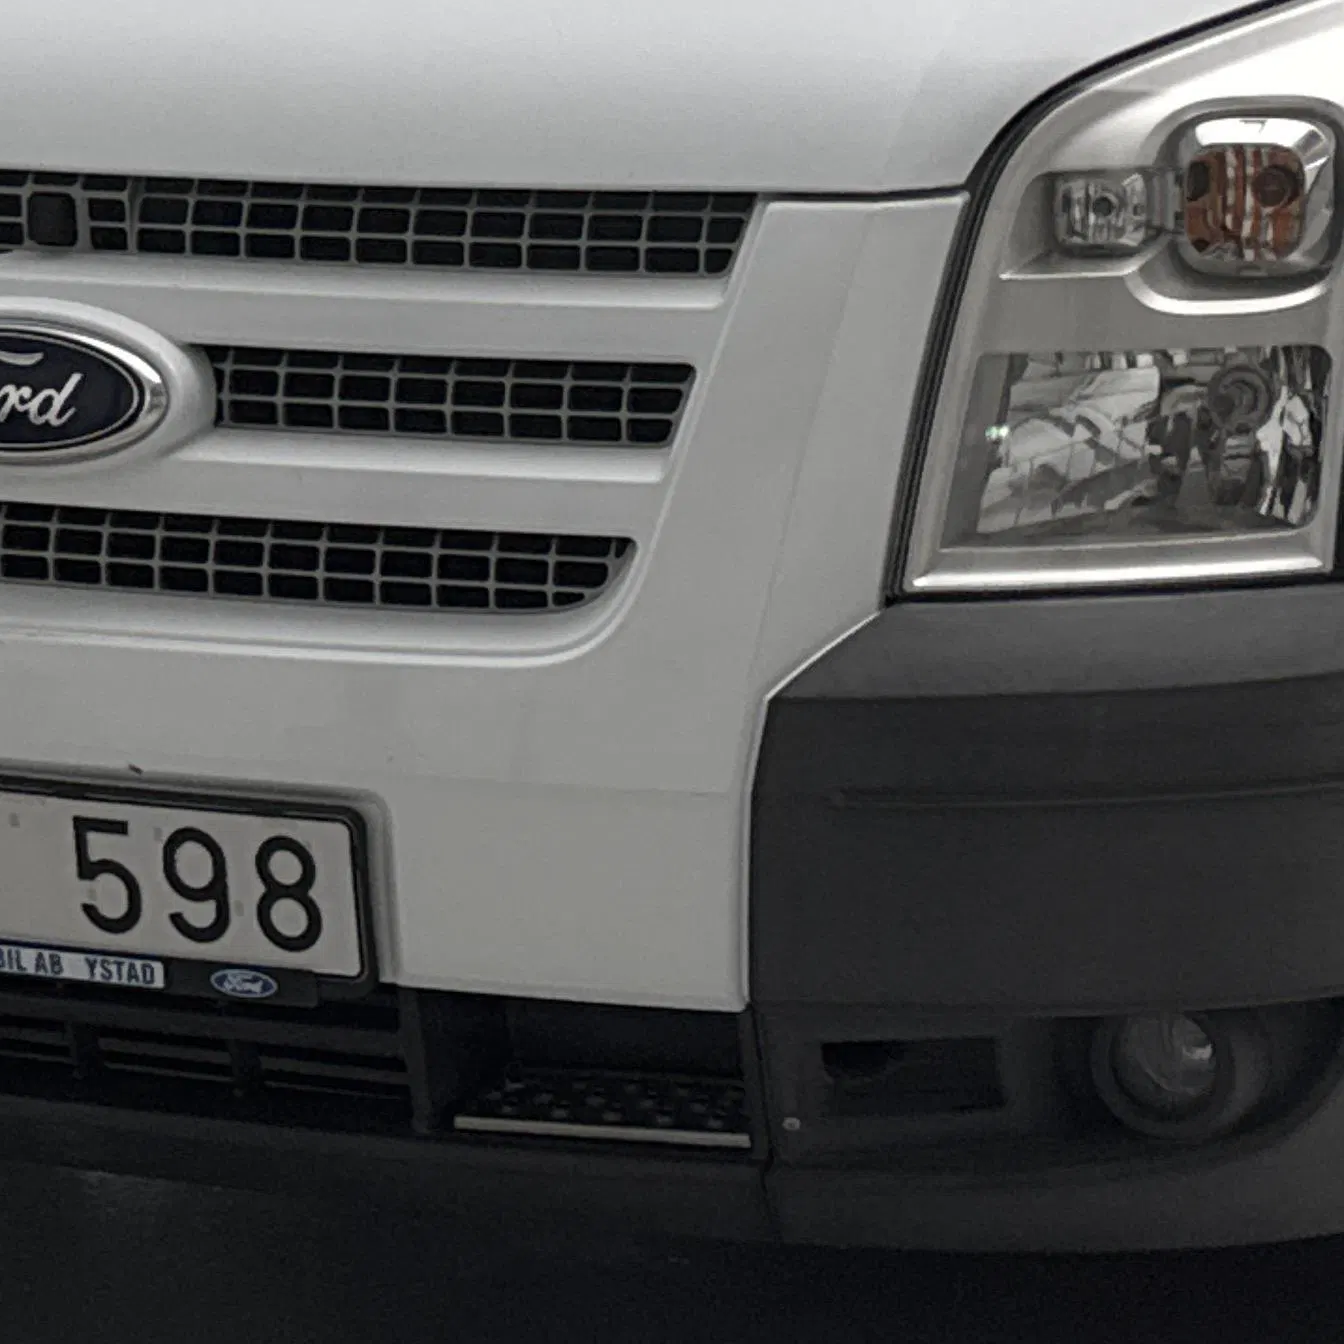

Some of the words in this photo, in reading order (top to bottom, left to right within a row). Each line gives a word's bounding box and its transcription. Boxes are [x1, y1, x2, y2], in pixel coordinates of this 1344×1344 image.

[71, 815, 322, 953] 598
[34, 951, 64, 976] AB
[84, 957, 155, 985] YSTAD
